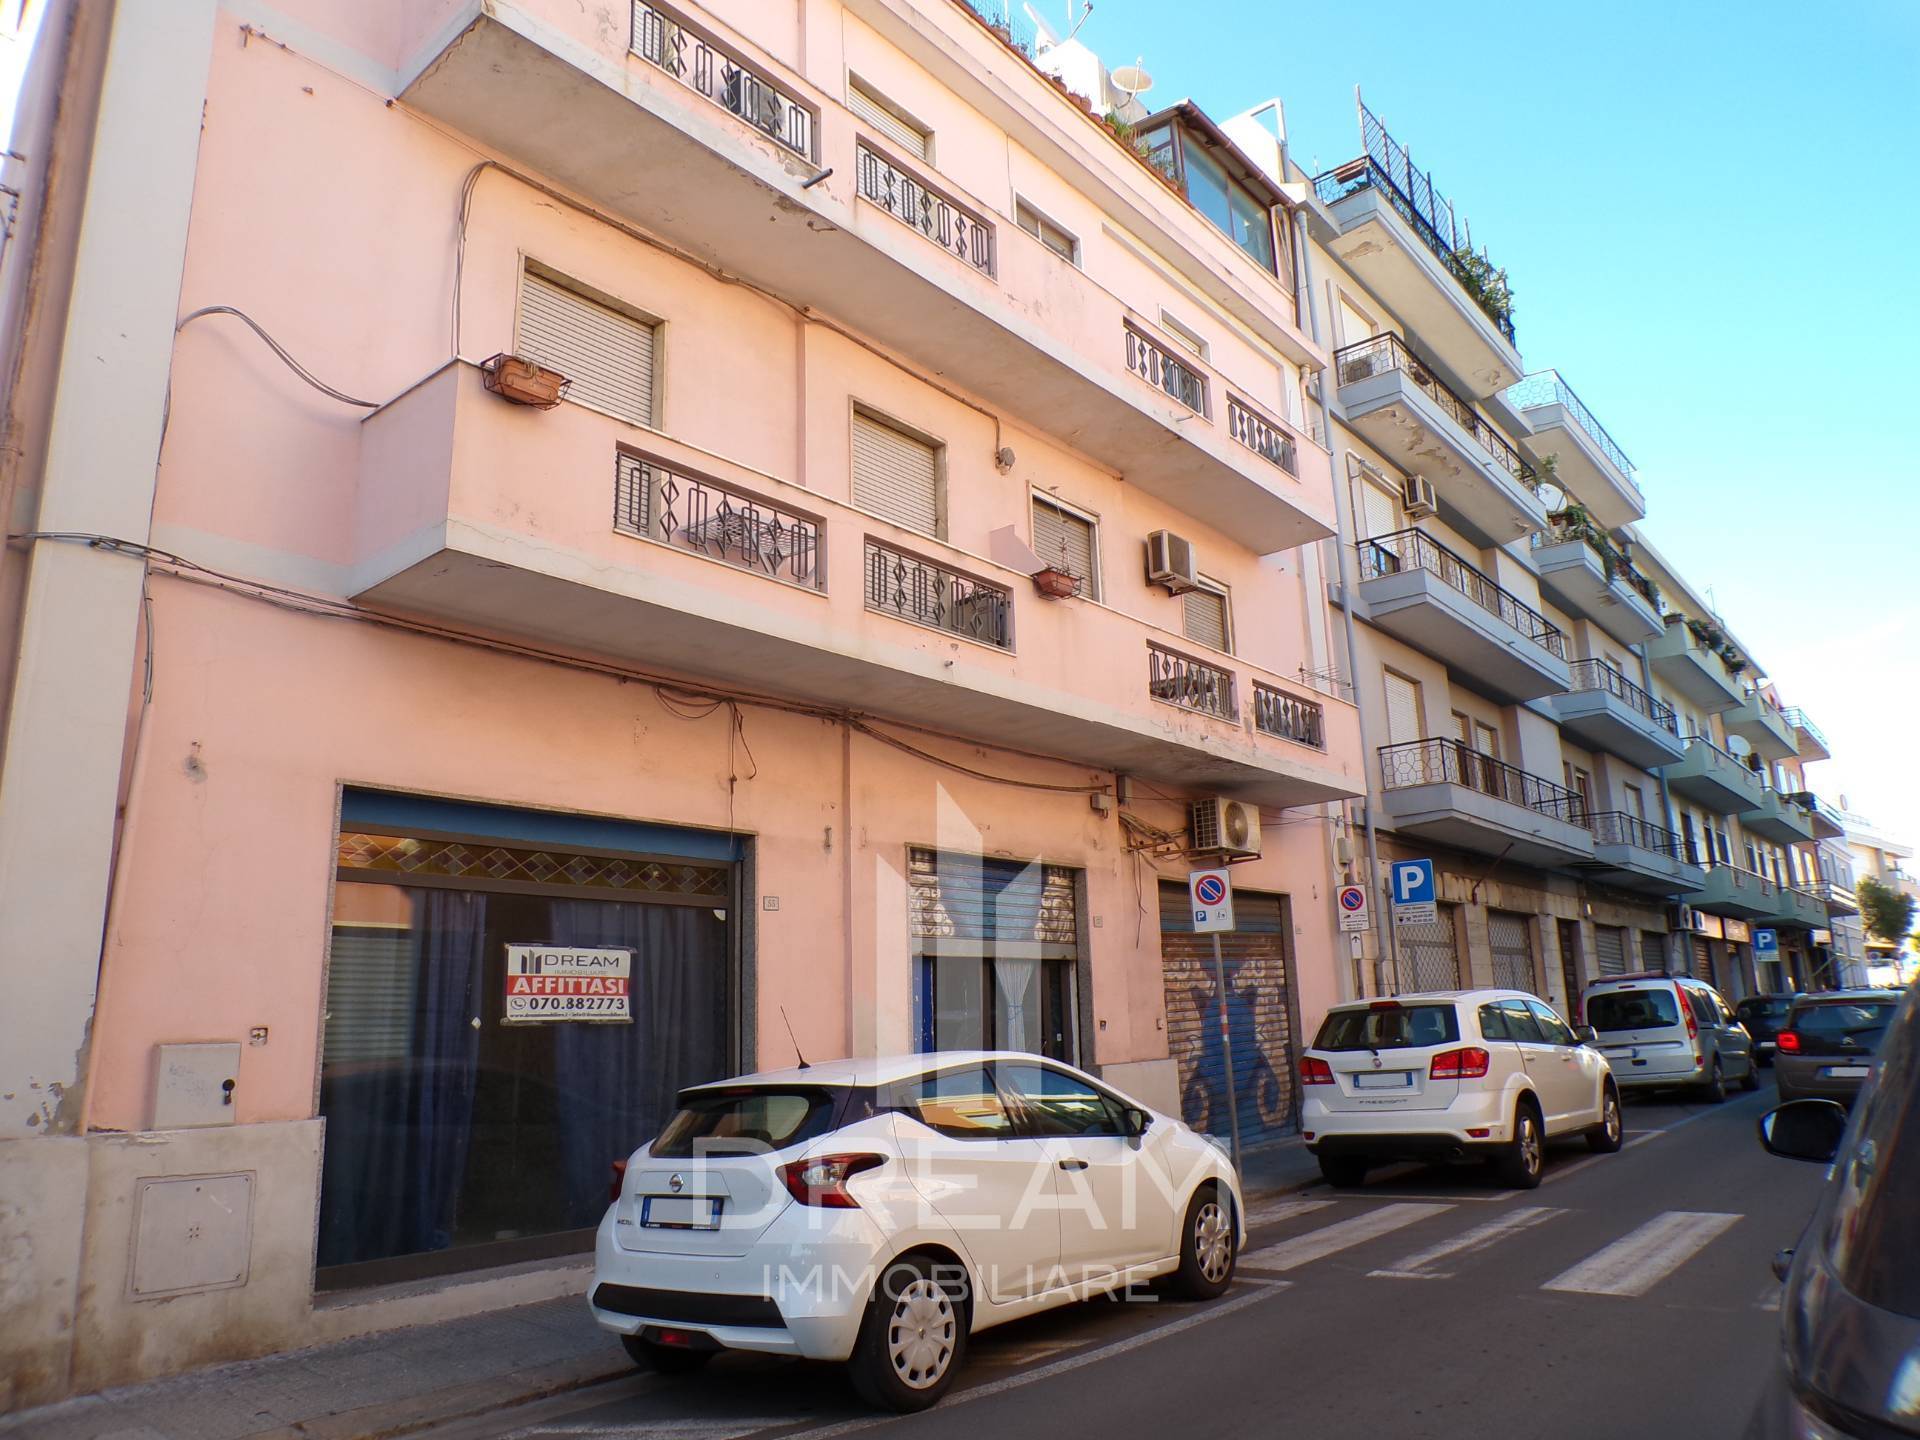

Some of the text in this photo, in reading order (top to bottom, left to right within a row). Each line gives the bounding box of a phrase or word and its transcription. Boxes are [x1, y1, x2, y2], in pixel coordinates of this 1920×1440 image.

[1401, 866, 1424, 899] P
[1197, 911, 1205, 920] P
[1758, 932, 1772, 948] P
[545, 954, 619, 967] DREAM
[512, 977, 625, 994] AFFITTASI
[529, 998, 625, 1010] 070.882773
